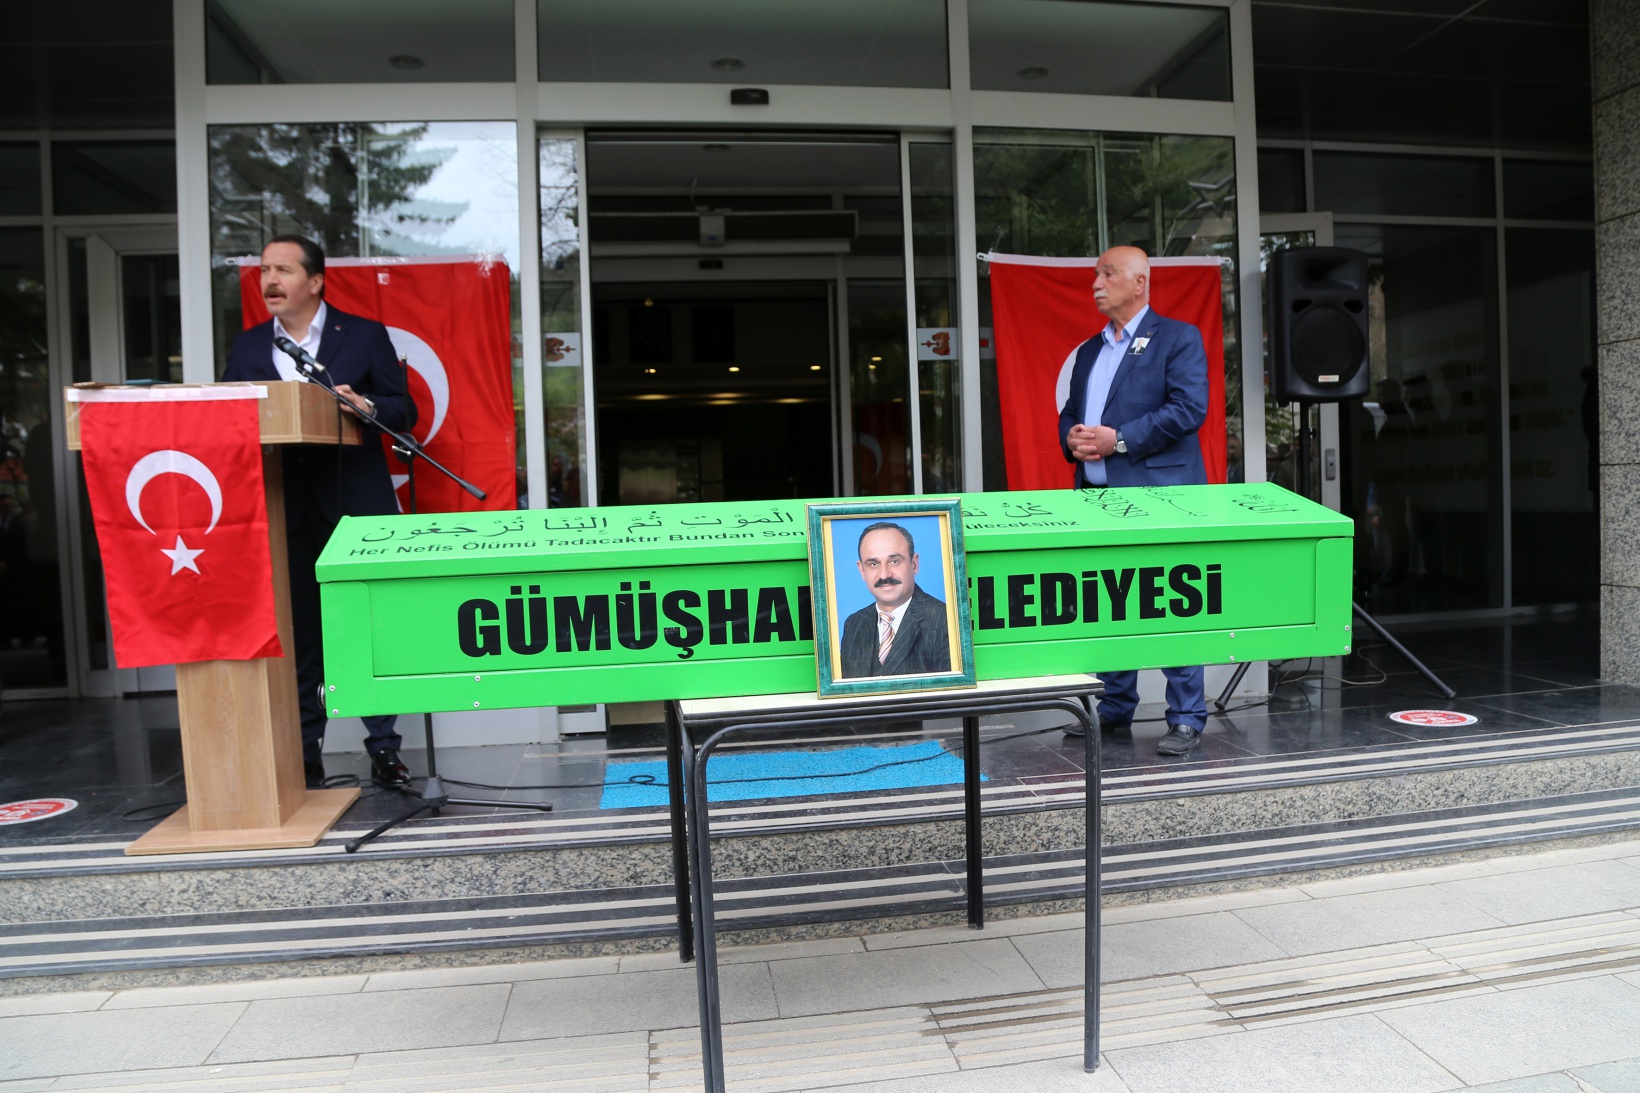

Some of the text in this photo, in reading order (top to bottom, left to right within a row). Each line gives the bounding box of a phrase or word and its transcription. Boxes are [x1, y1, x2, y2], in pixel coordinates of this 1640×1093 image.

[350, 547, 390, 557] Her
[396, 544, 454, 554] Nefis
[462, 539, 537, 551] Ölümü
[545, 536, 662, 547] Tadacaktır
[669, 532, 755, 542] Bundan
